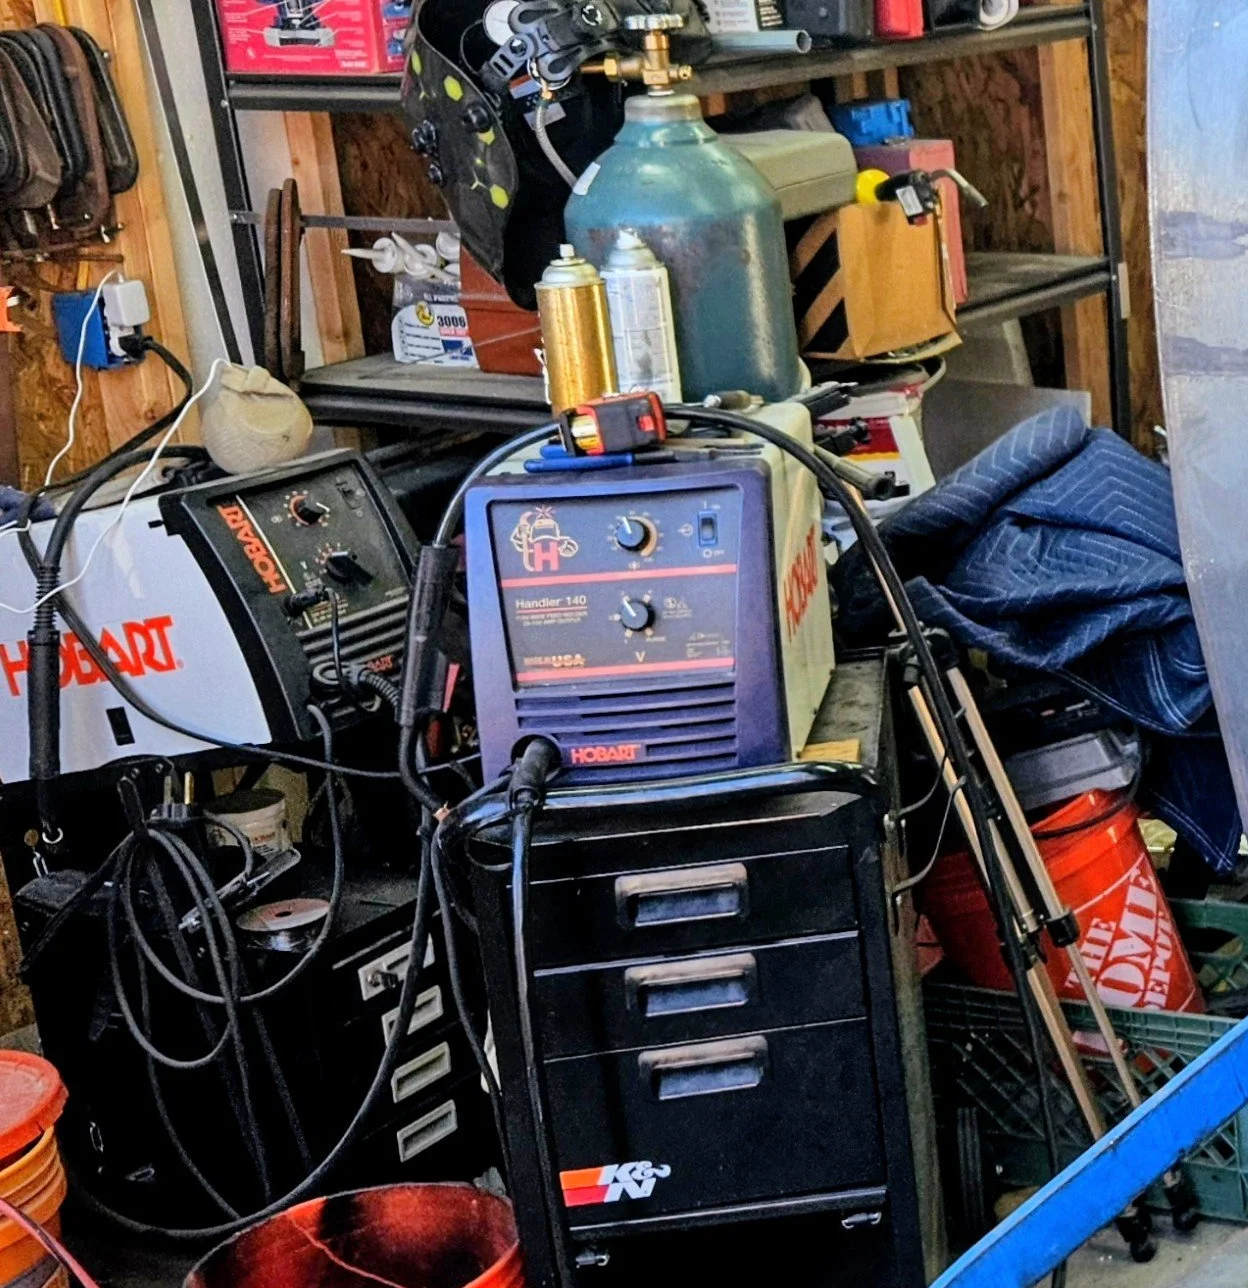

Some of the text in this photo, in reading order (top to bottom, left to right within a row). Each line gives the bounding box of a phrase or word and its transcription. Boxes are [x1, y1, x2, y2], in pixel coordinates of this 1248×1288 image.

[215, 502, 287, 594] HOBART
[515, 595, 587, 609] Handler 140
[783, 522, 818, 644] HOBART
[552, 654, 585, 668] USA
[570, 743, 640, 764] HOBART
[1096, 865, 1157, 1009] OME
[1143, 910, 1173, 1009] EPOT
[597, 1159, 672, 1204] K&N
